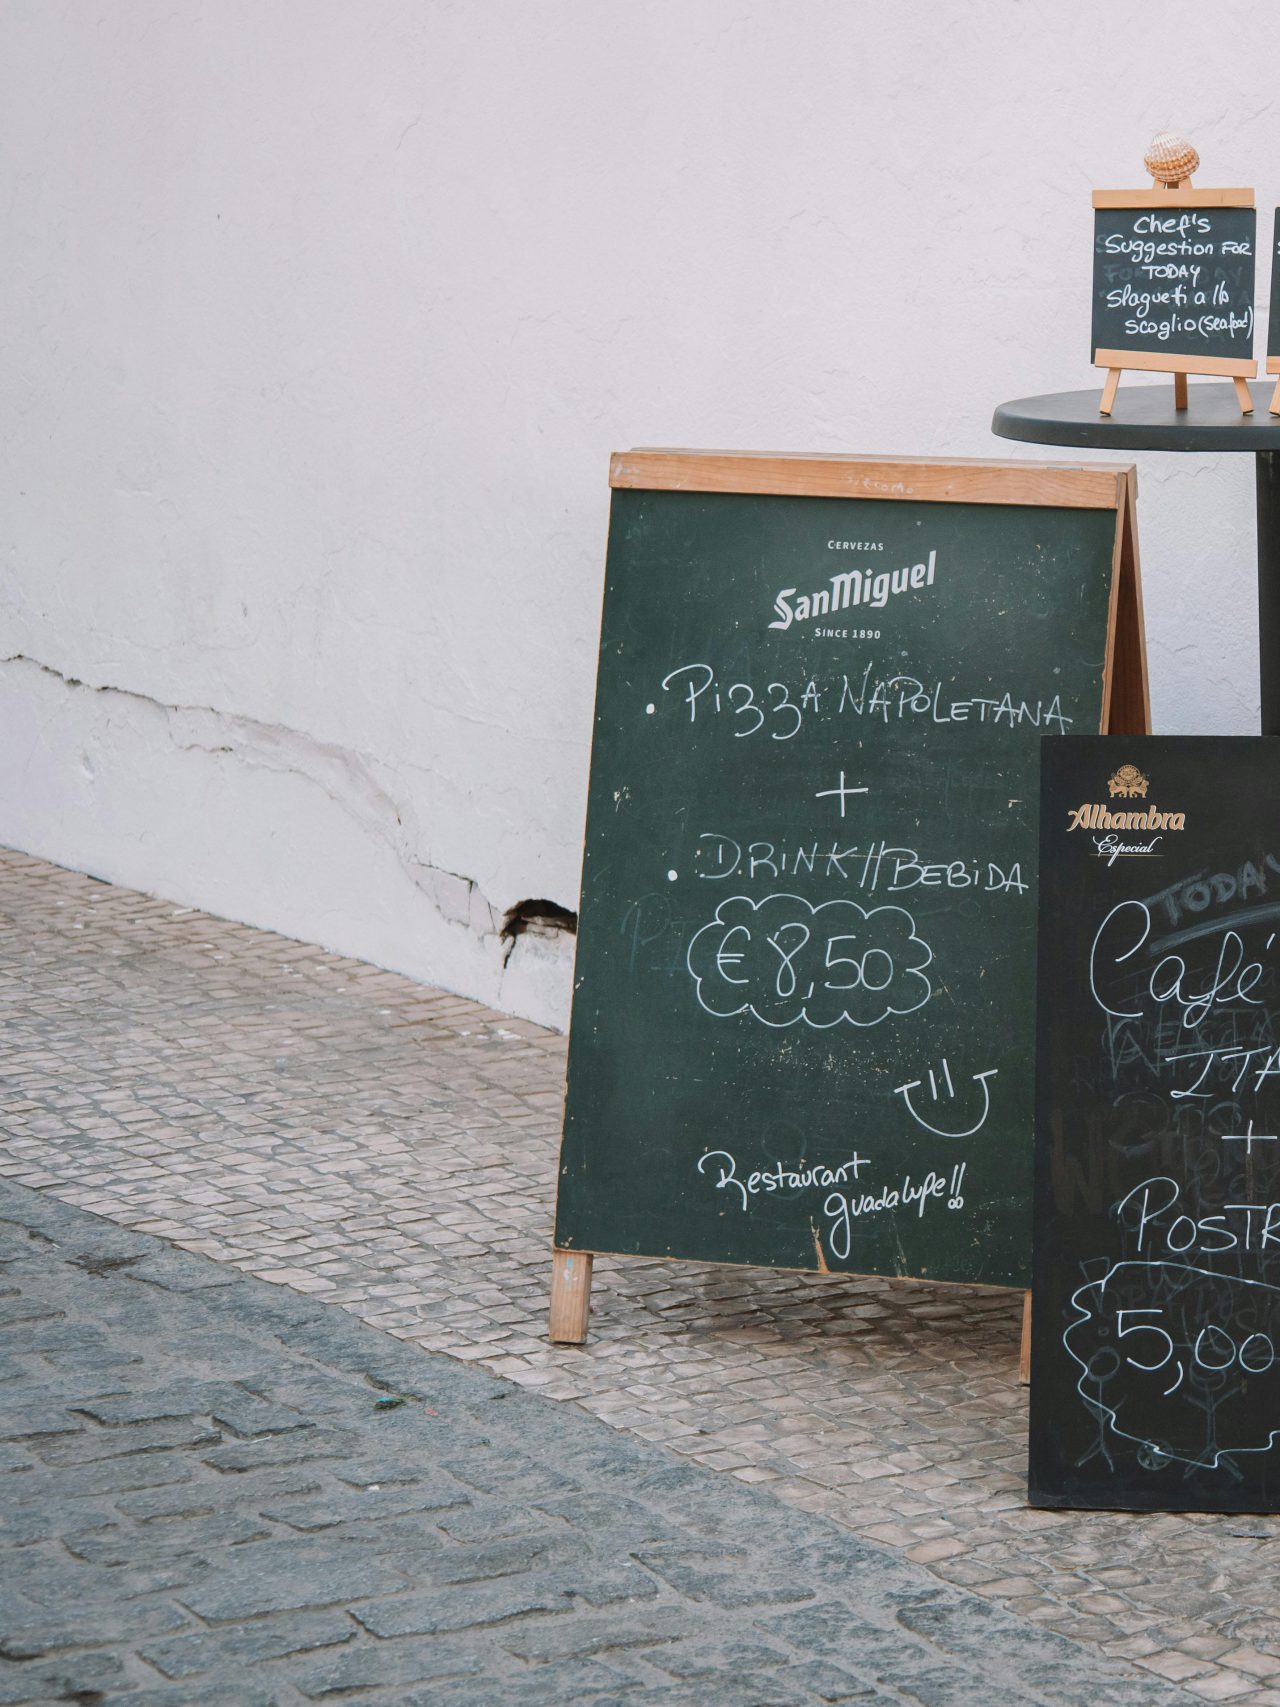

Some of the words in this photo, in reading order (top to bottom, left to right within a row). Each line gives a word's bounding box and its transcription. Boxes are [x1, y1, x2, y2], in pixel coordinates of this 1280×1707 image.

[1134, 214, 1211, 237] Chef's
[1105, 235, 1213, 262] Suggestion
[1142, 264, 1200, 287] TODAY
[828, 540, 884, 551] CERVEZAS
[815, 627, 848, 639] SINCE
[852, 629, 881, 640] 1890
[840, 661, 1074, 736] NAPOLETANA
[1066, 804, 1186, 831] Alhambra
[1092, 834, 1163, 867] Especial
[1090, 901, 1276, 1028] Café
[698, 1150, 871, 1211] Restaurant
